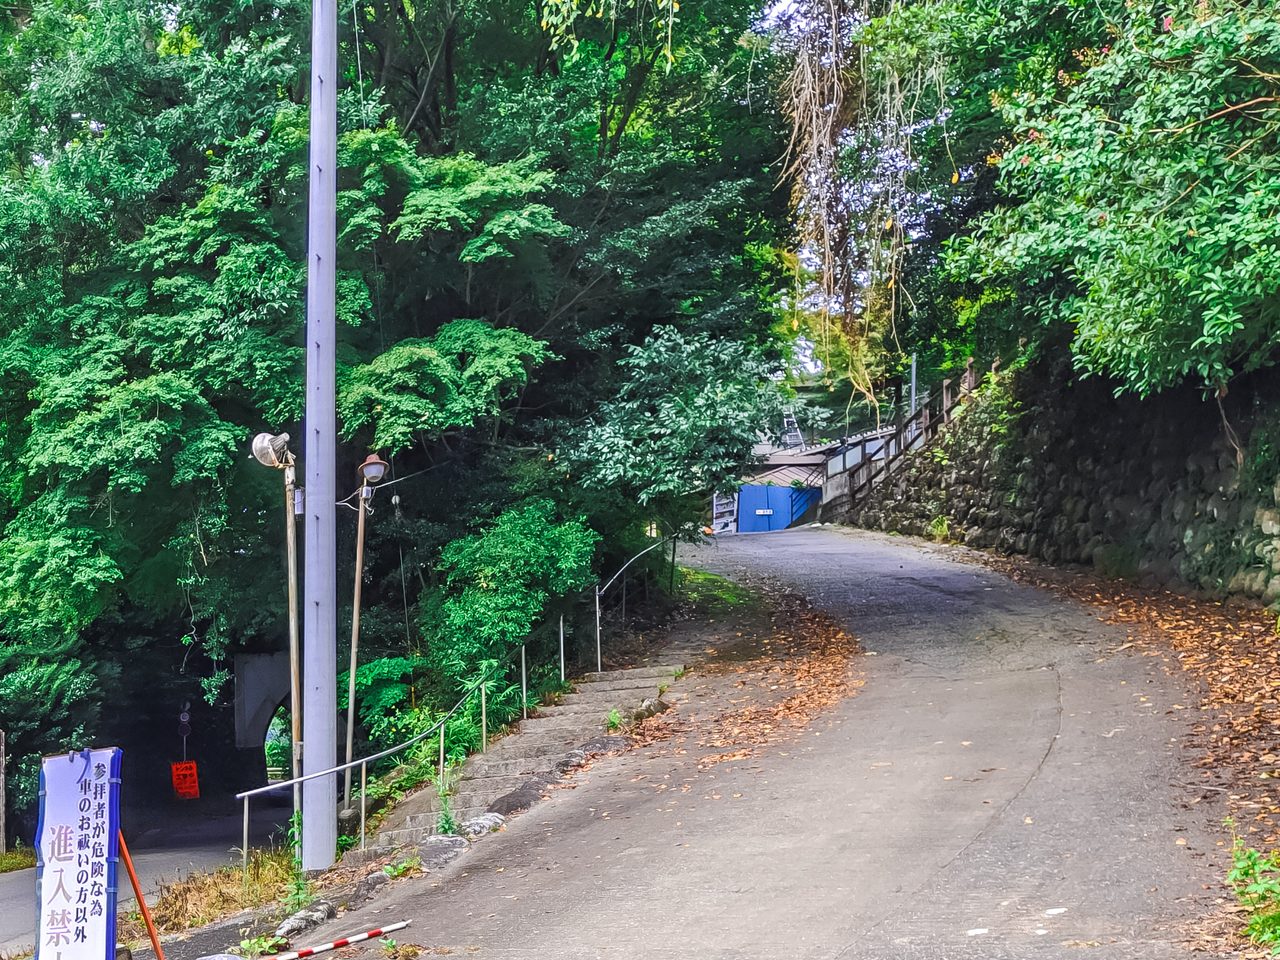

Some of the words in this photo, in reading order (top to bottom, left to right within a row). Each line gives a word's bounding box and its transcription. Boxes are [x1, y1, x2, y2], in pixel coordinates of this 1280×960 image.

[74, 779, 93, 943] 車のお祓いの方以外
[90, 762, 106, 917] 参拝者が危険な為
